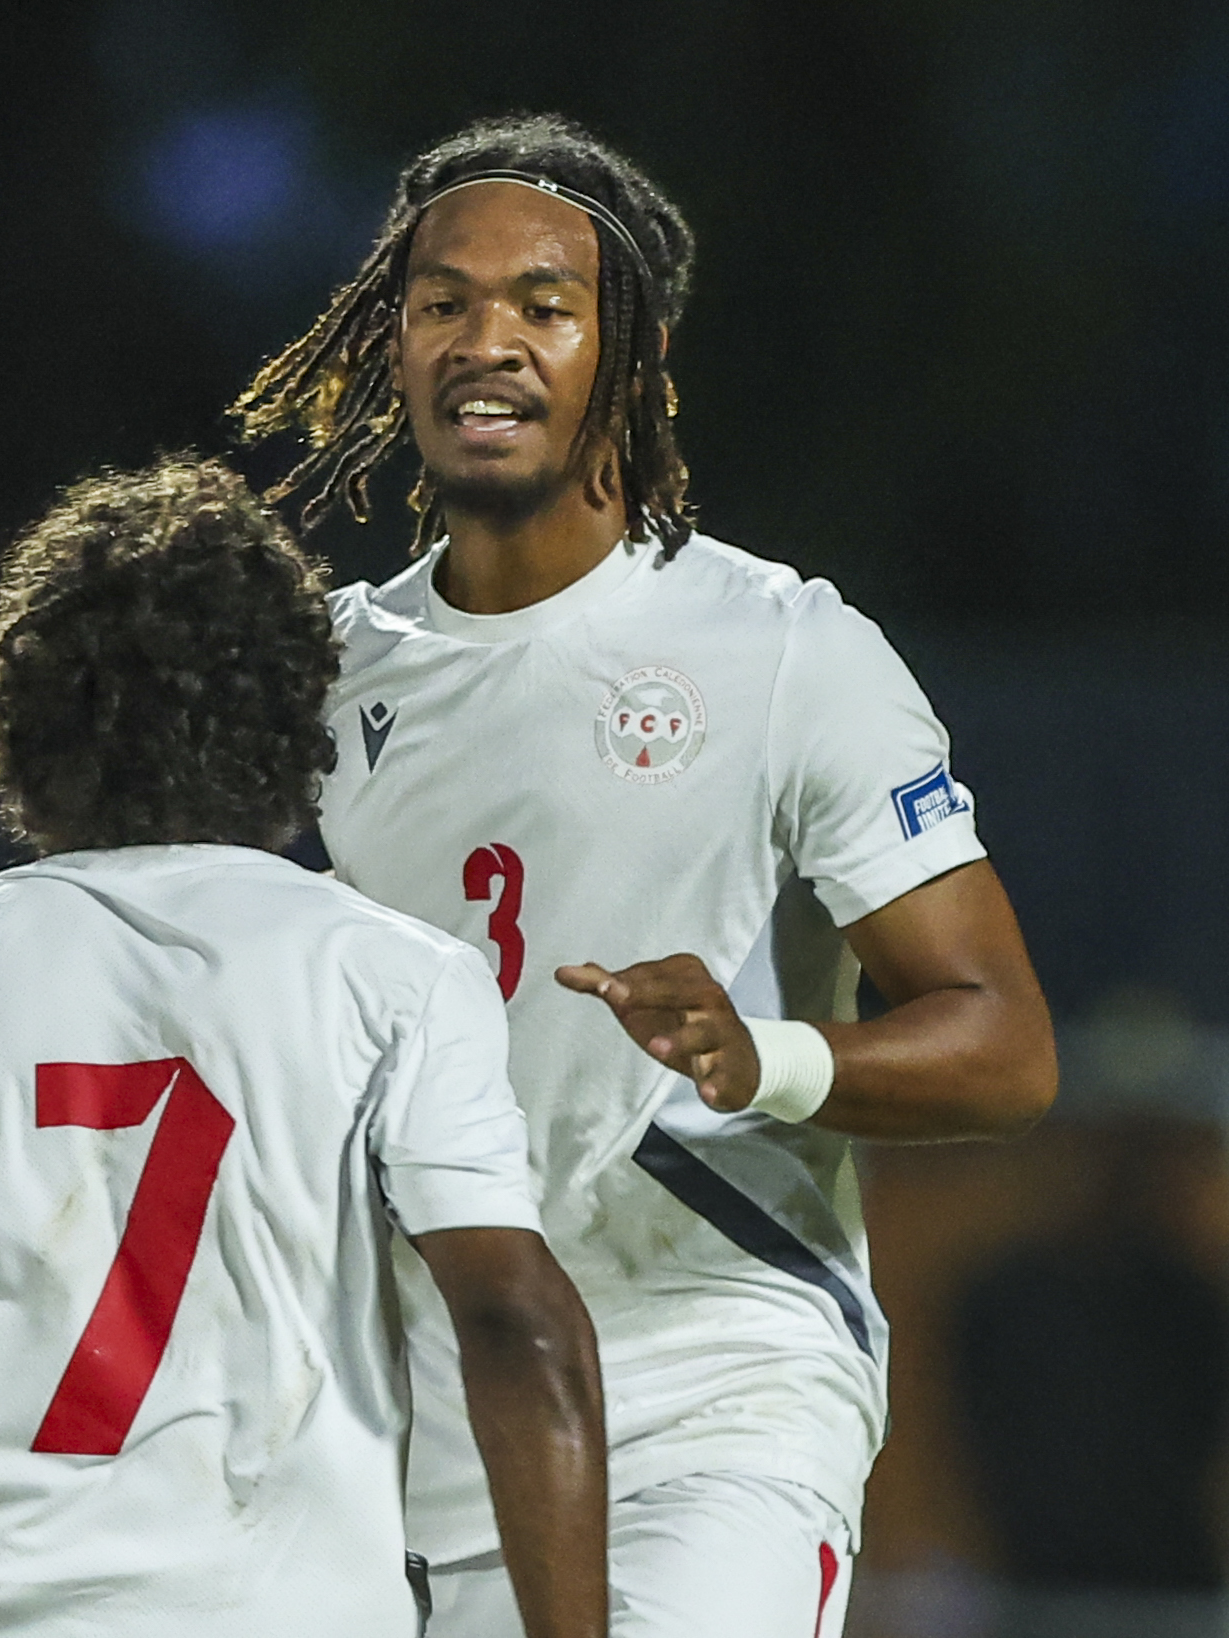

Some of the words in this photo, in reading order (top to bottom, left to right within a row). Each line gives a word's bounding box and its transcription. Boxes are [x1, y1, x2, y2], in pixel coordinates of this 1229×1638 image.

[619, 712, 682, 737] FCF
[623, 767, 683, 783] FOOTBALL
[463, 842, 525, 1004] 3
[31, 1056, 236, 1456] 7
